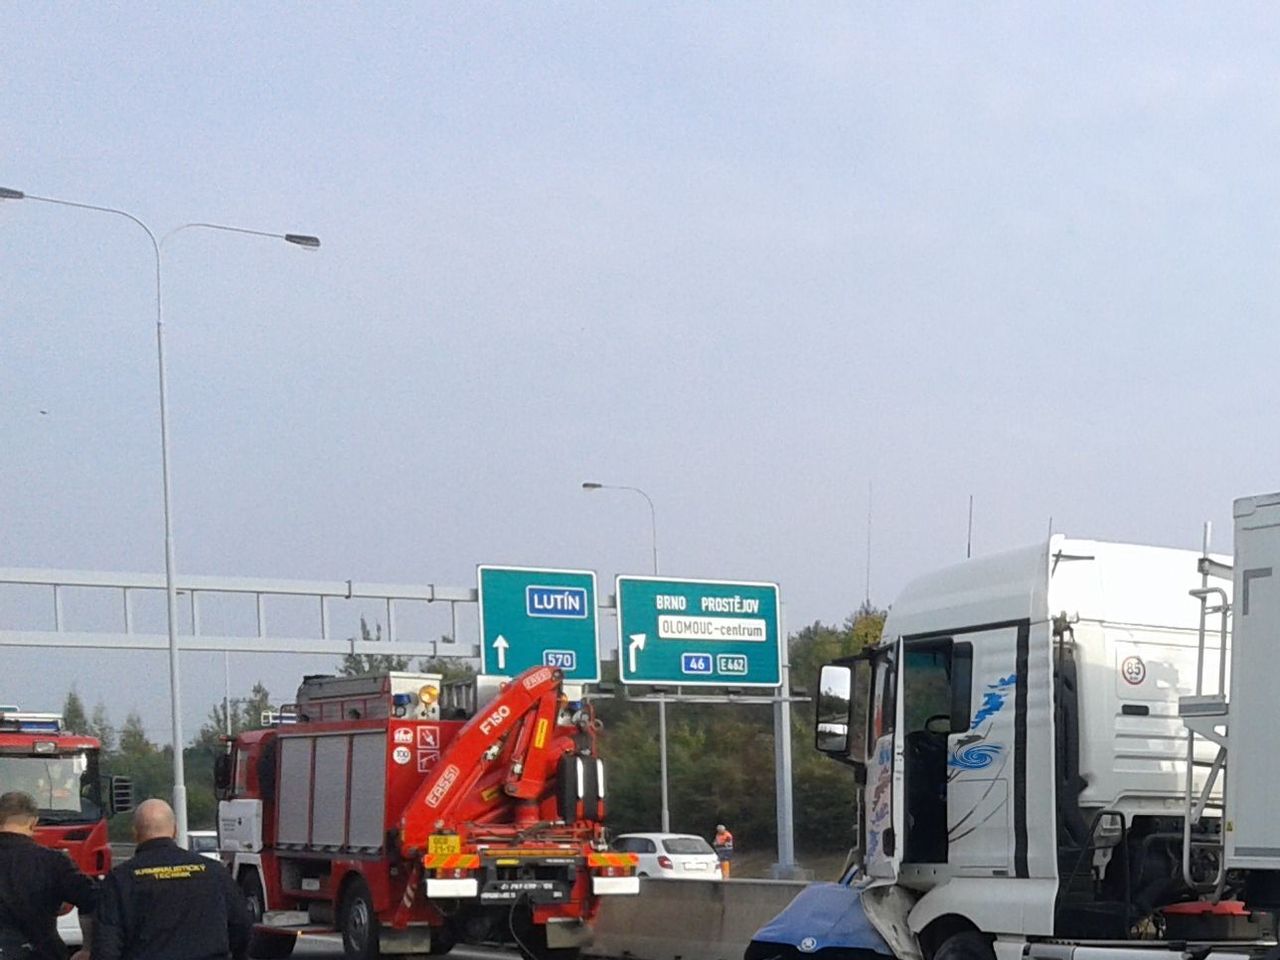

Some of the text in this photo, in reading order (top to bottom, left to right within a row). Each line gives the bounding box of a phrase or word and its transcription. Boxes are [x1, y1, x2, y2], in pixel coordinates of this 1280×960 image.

[534, 591, 579, 611] LUTÍN
[656, 595, 759, 613] BRNO PROSTĚJOV
[662, 620, 763, 637] OLOMOUC-centrum
[548, 654, 571, 667] 570
[689, 658, 705, 670] 46
[1127, 661, 1141, 675] 85
[480, 705, 511, 735] F150
